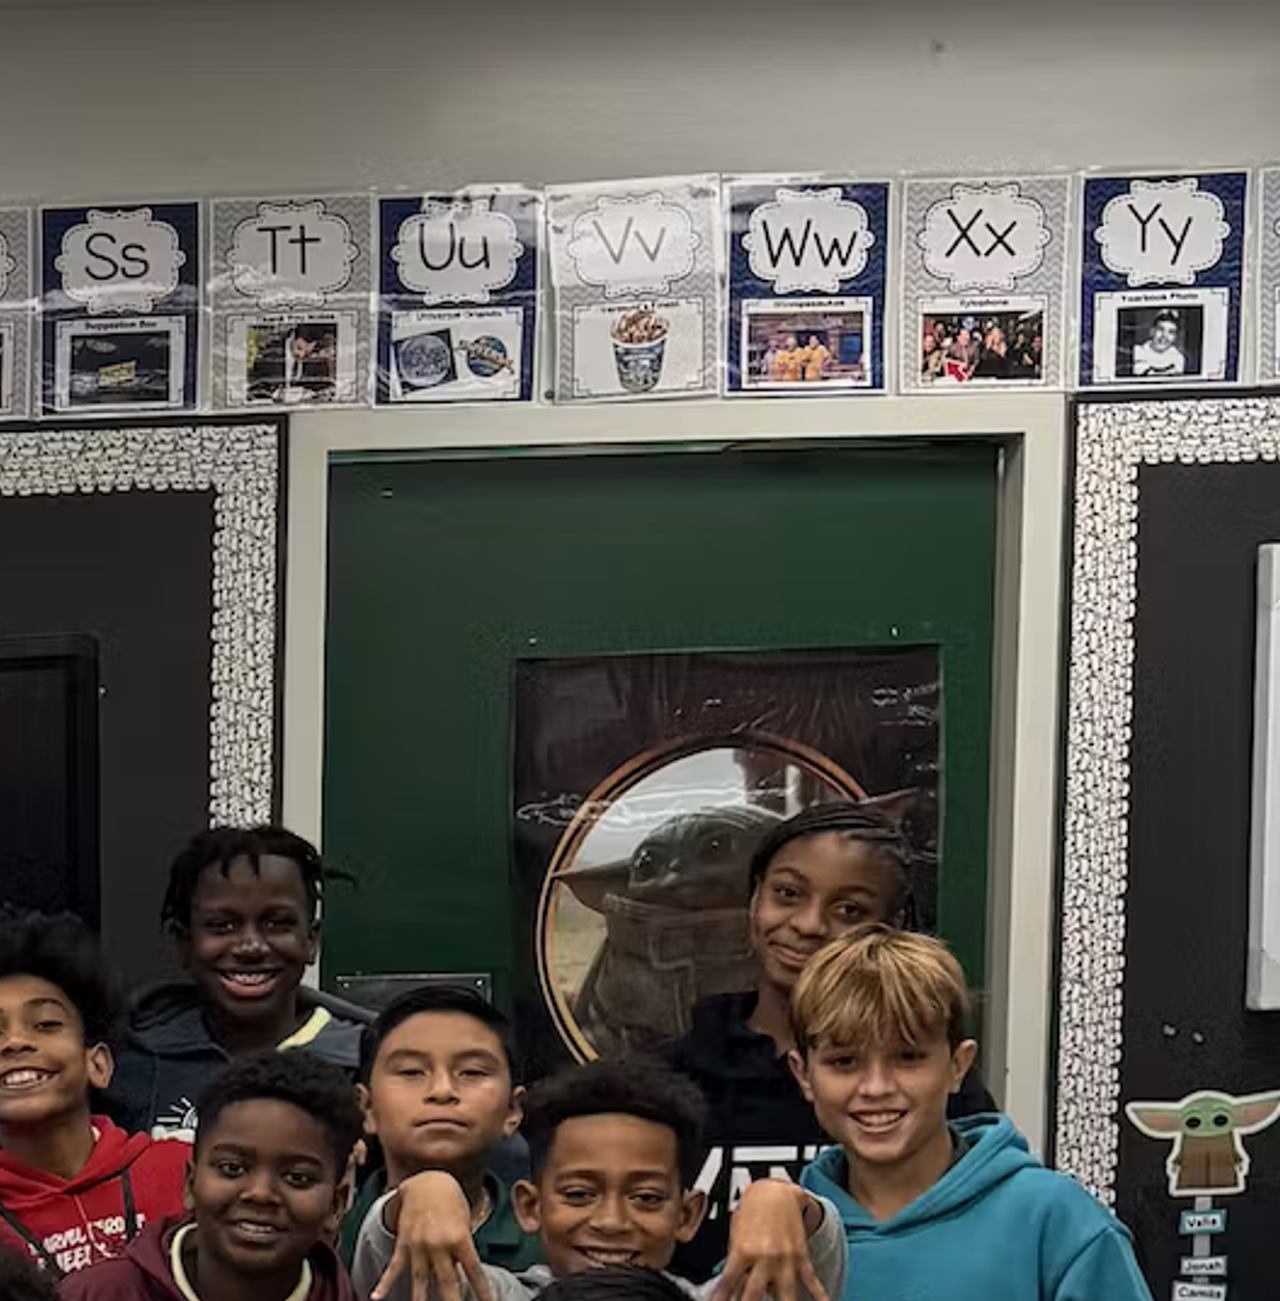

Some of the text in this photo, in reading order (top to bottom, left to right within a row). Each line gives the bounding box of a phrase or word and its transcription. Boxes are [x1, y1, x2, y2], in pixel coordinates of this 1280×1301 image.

[84, 232, 151, 281] Ss
[257, 223, 321, 275] Tt
[419, 222, 491, 271] Uu
[592, 216, 666, 265] Vv
[762, 218, 859, 268] Ww
[945, 208, 1018, 257] Xx
[1127, 203, 1193, 266] Yy
